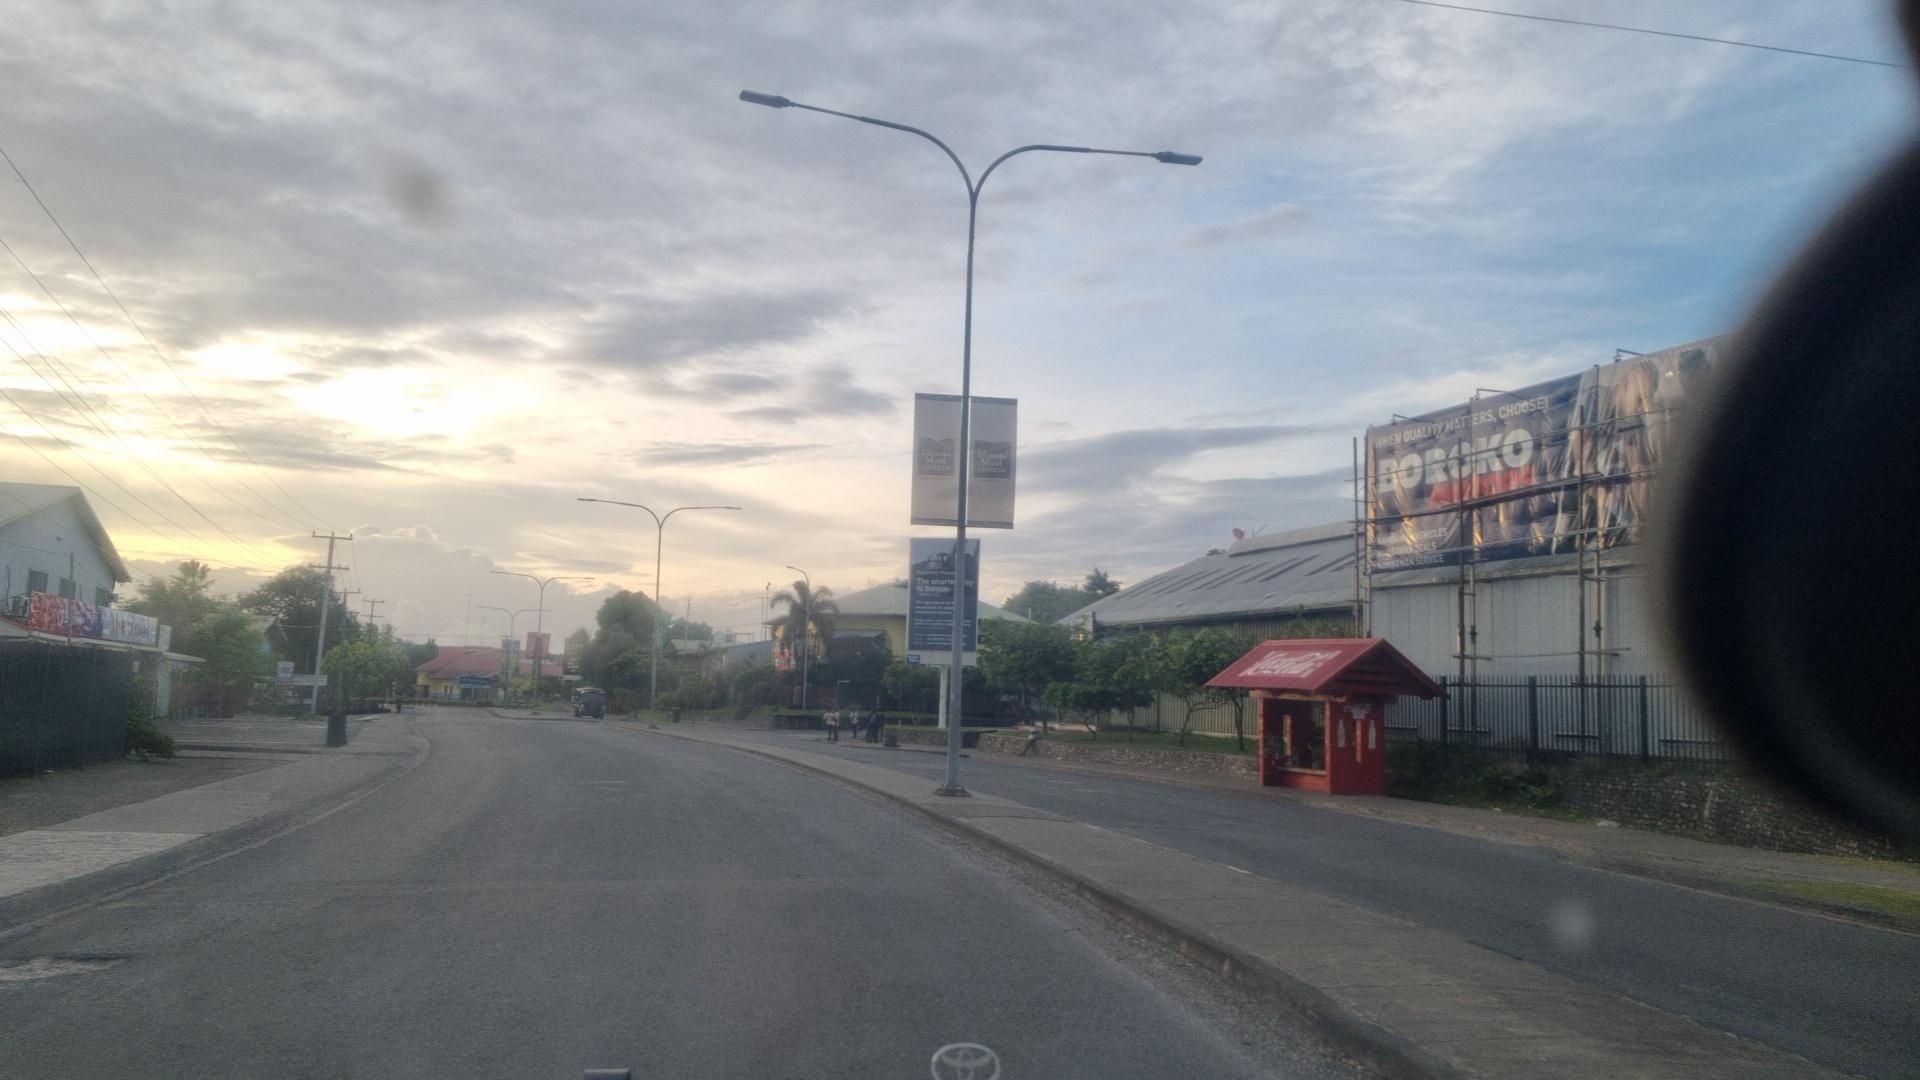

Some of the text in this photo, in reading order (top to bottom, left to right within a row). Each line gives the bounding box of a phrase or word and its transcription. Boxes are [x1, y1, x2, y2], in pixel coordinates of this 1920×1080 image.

[1375, 432, 1402, 449] WHEN
[1403, 421, 1442, 443] QUALITY
[1498, 396, 1549, 419] CHOOSE!
[1378, 428, 1534, 493] BOROKO
[917, 577, 929, 585] The
